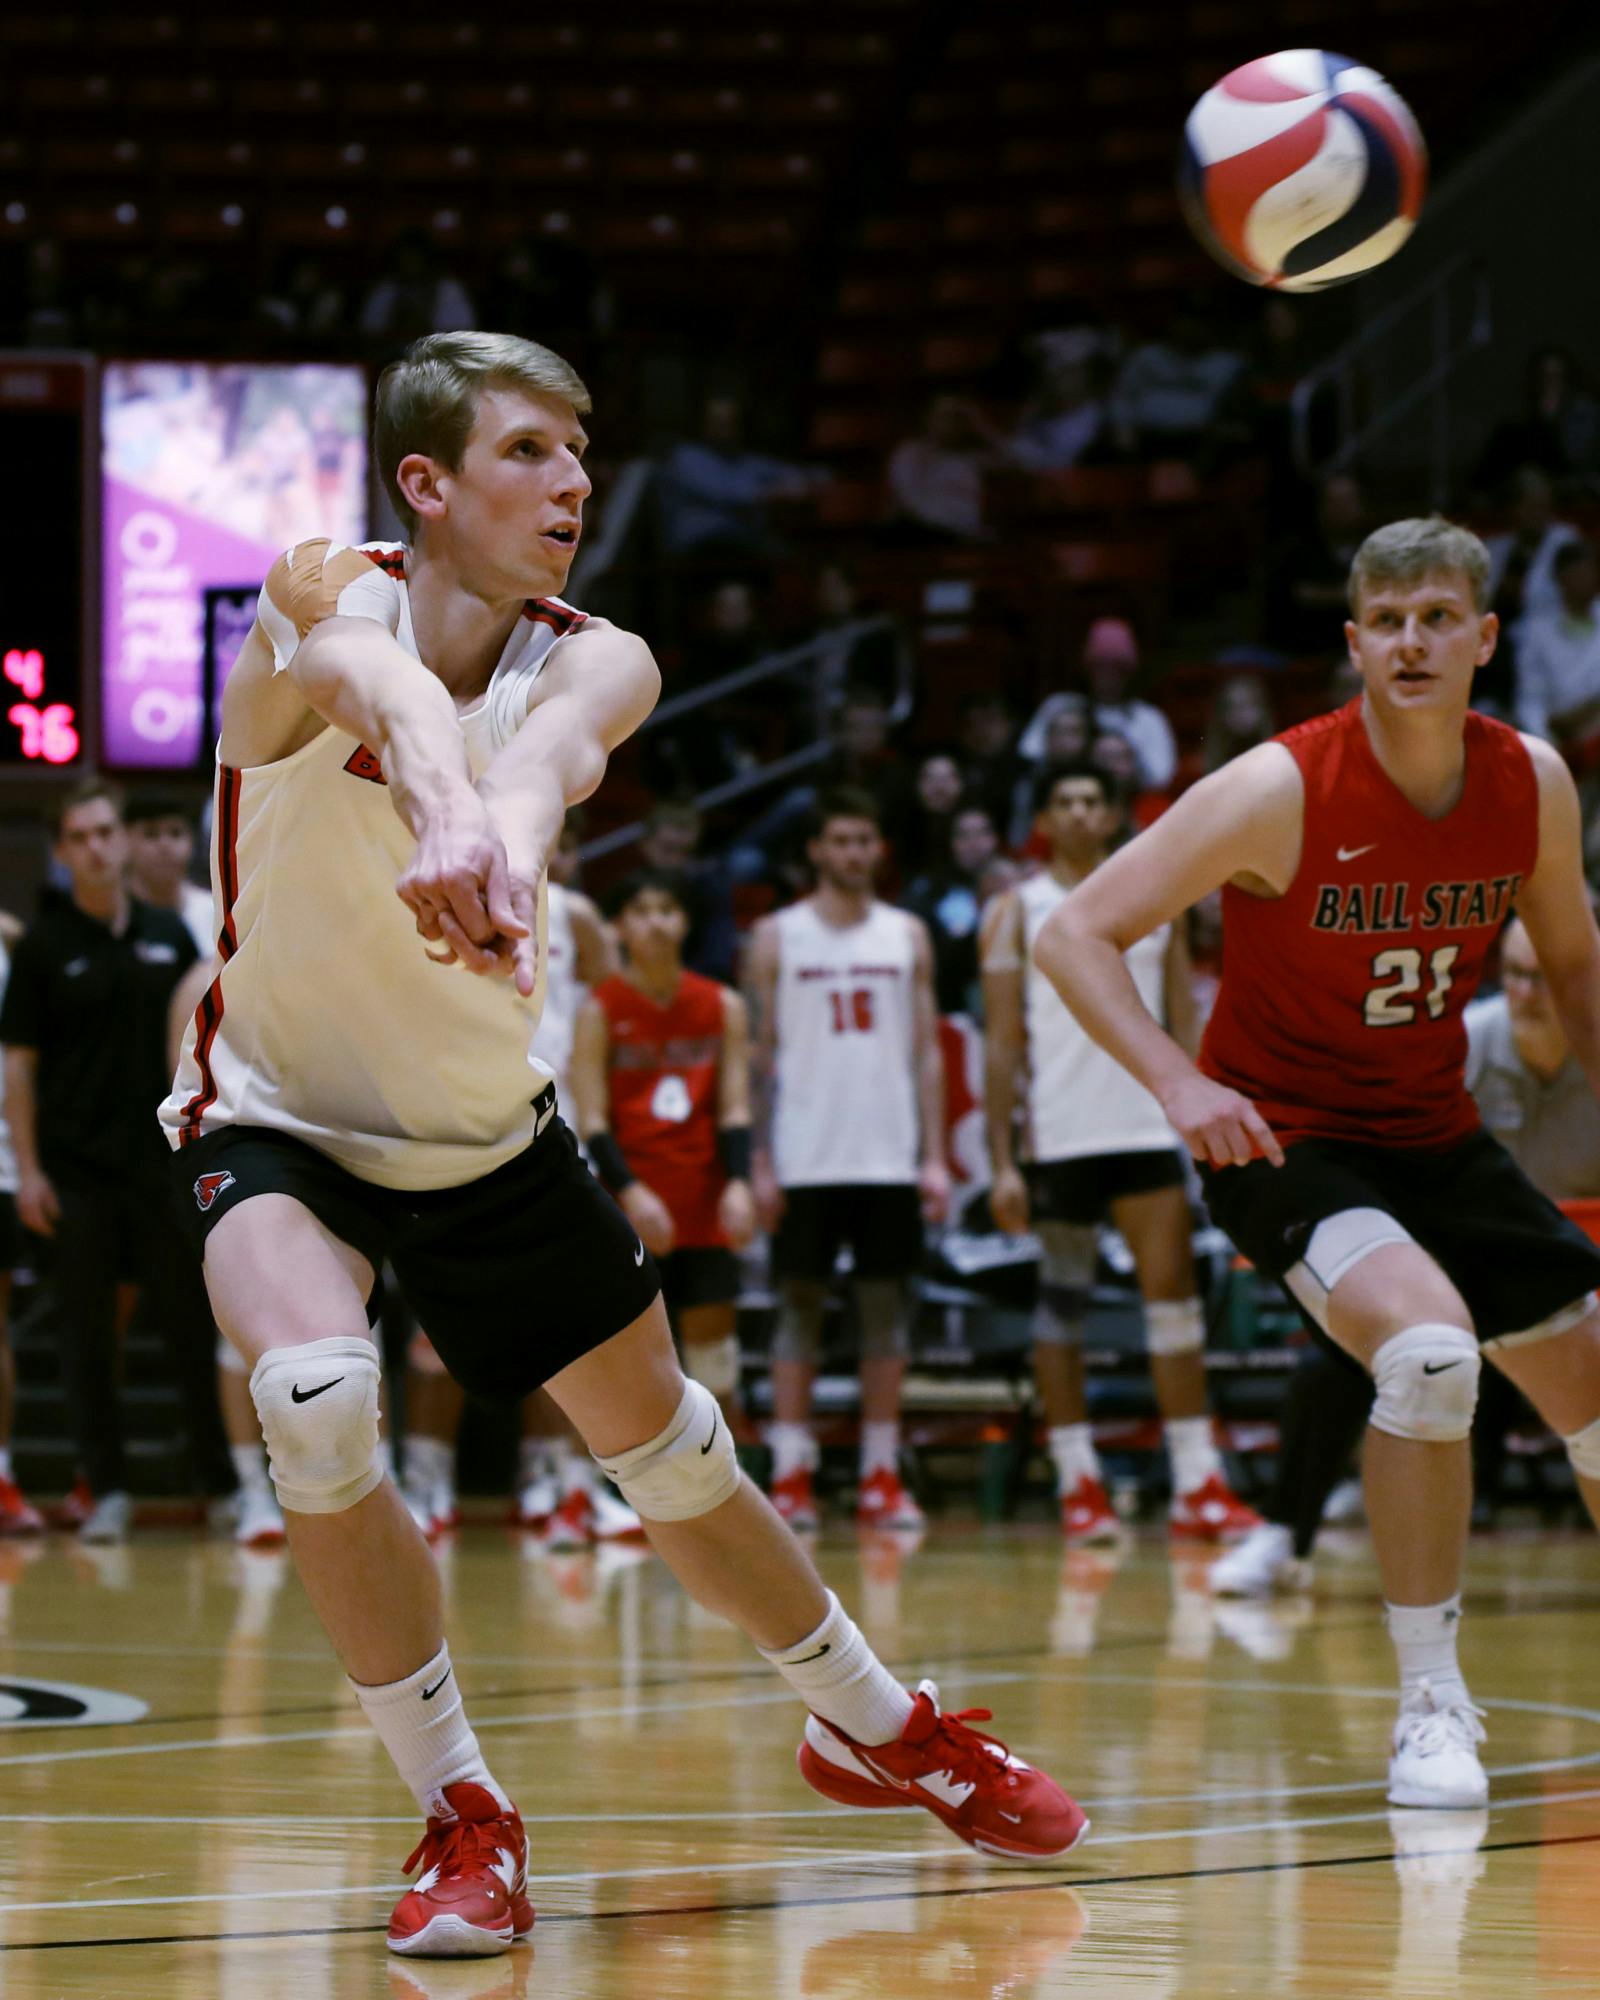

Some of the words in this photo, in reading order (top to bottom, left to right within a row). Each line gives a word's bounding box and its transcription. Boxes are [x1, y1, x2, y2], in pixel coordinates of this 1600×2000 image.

[3, 648, 45, 699] 4
[1309, 882, 1414, 935] BALL
[1362, 943, 1462, 1028] 21
